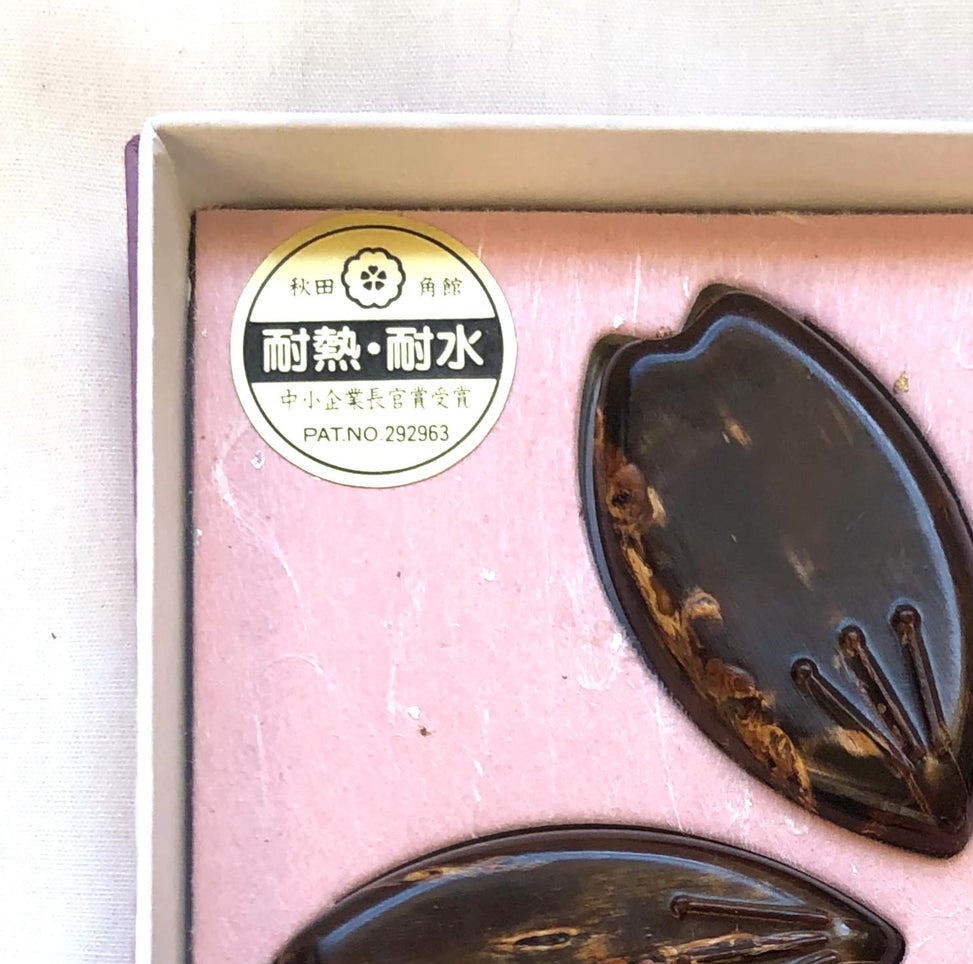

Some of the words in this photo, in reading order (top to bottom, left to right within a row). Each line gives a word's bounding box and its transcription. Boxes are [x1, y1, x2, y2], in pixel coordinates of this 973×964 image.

[289, 277, 334, 297] 秋田
[420, 277, 463, 297] 角館
[280, 386, 472, 411] 中小企業長官賞受賞
